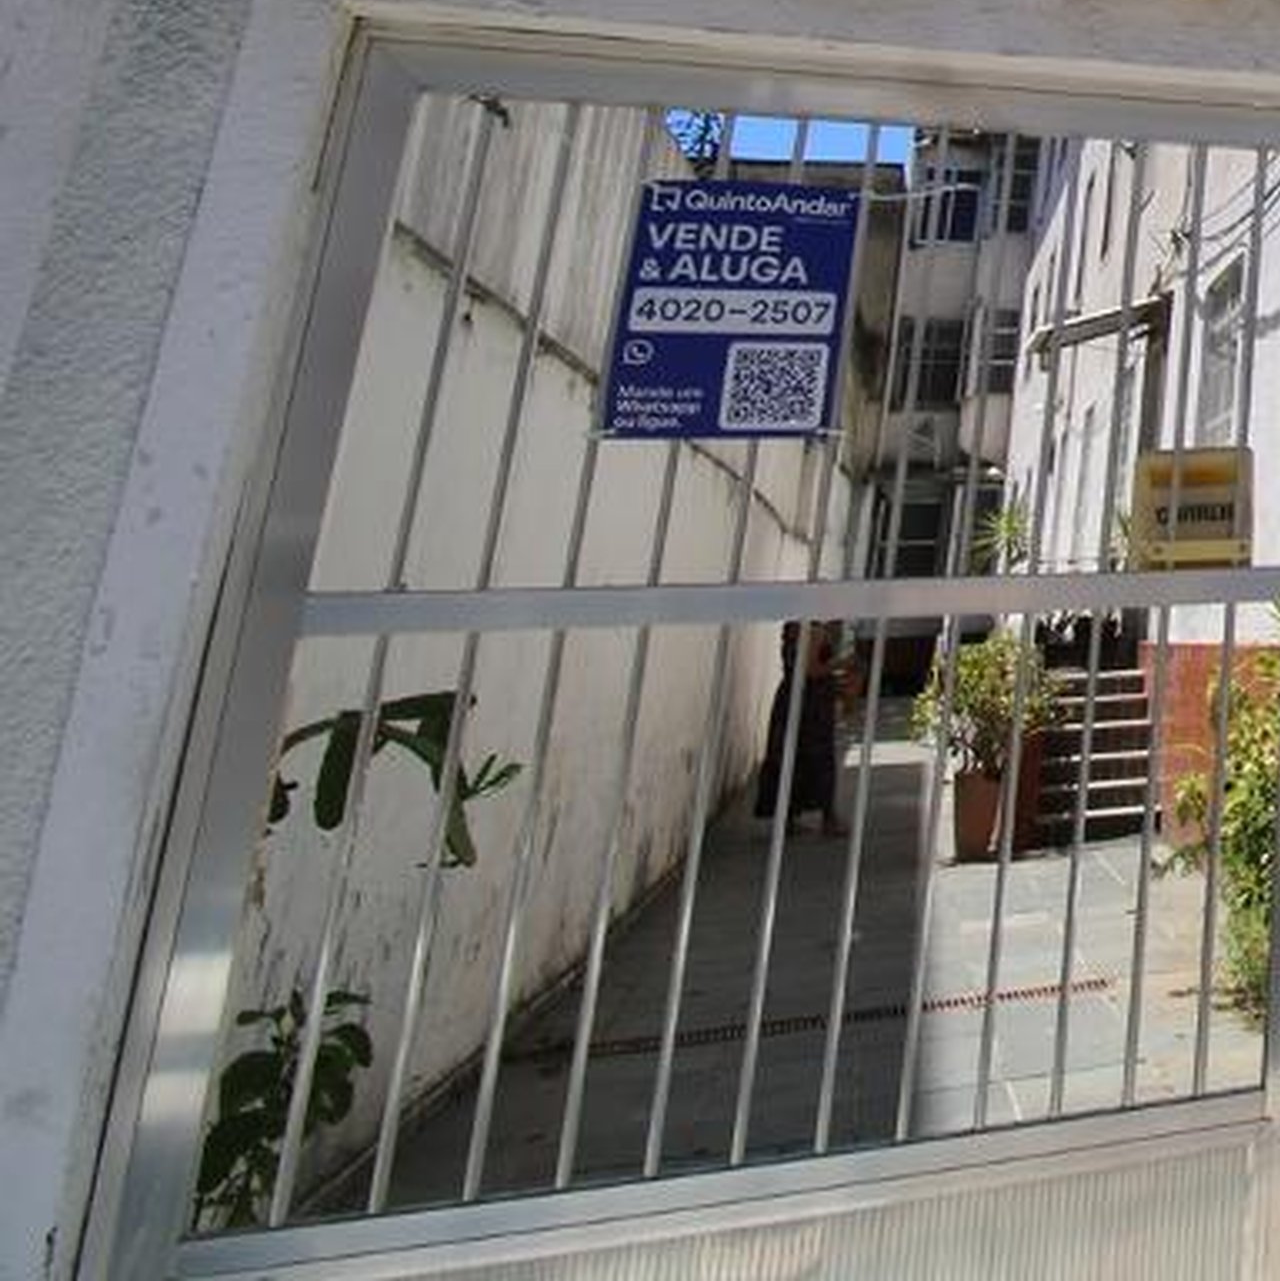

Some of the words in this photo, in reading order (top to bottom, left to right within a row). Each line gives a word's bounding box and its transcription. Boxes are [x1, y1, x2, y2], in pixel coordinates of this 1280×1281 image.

[685, 189, 850, 217] QuintoAndar
[649, 223, 785, 252] VENDE
[639, 258, 661, 281] &
[668, 254, 808, 284] ALUGA
[635, 298, 831, 324] 4020-2507
